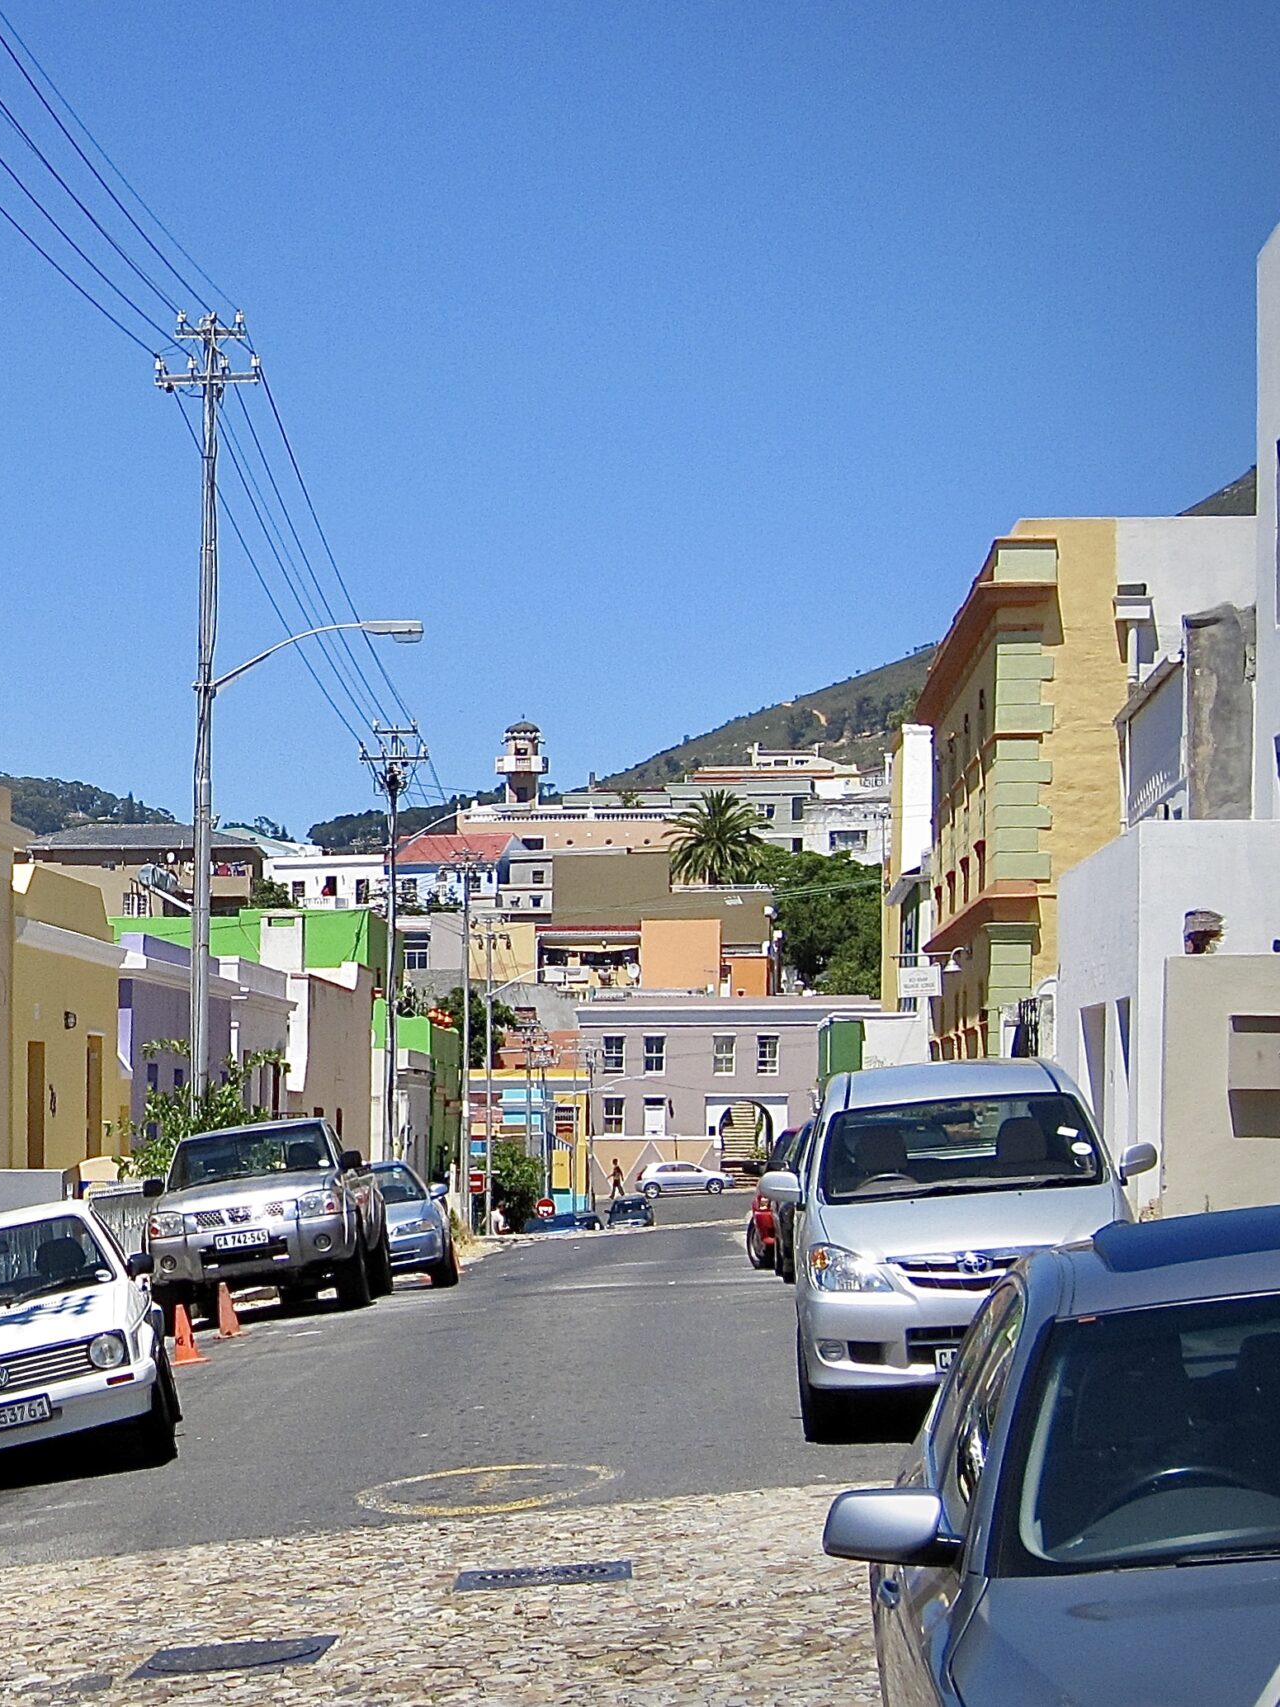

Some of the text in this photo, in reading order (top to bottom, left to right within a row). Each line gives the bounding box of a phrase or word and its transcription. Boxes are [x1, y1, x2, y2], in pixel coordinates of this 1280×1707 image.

[217, 1231, 267, 1248] CA 742-545
[939, 1351, 957, 1369] C
